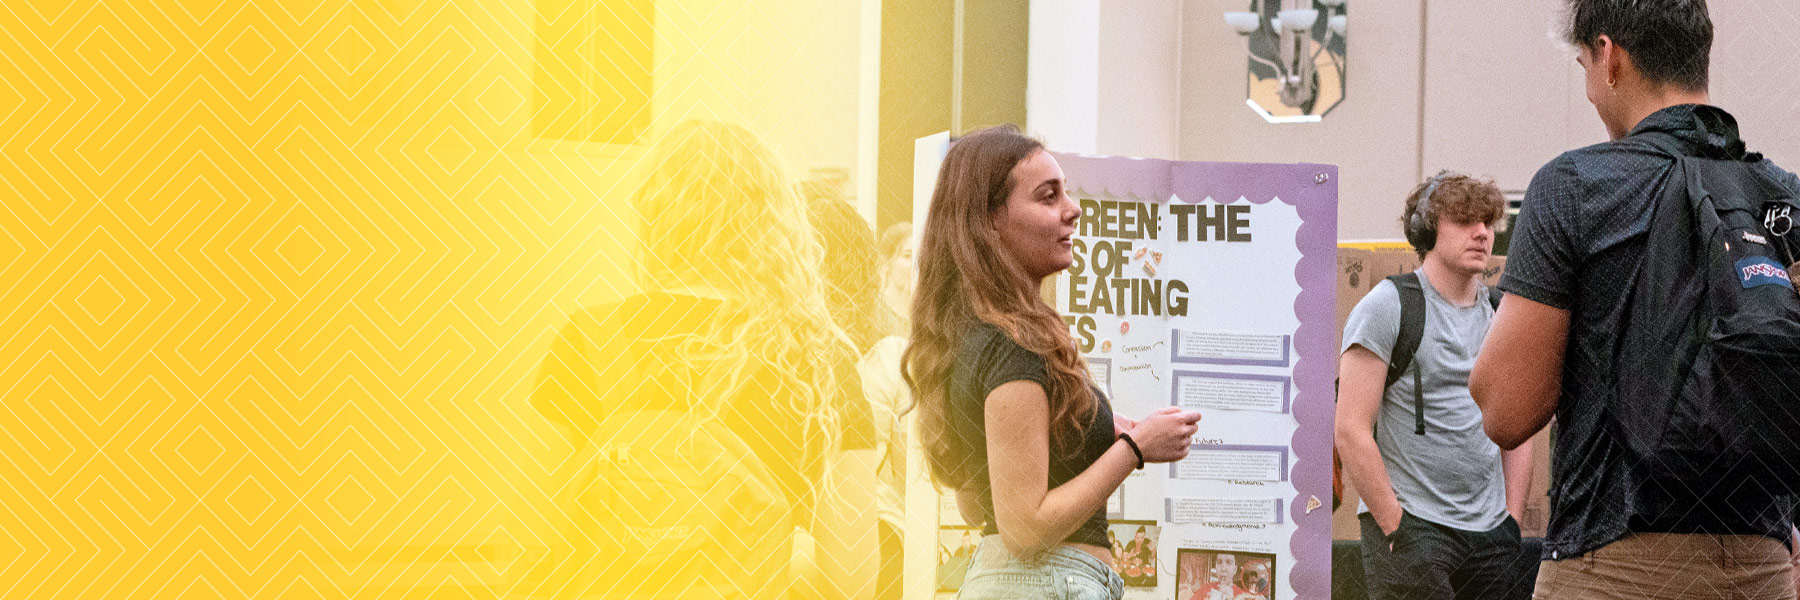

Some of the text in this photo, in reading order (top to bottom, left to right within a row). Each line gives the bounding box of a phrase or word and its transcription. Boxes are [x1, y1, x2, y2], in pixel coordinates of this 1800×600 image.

[1075, 198, 1252, 242] REEN: THE
[1091, 240, 1132, 278] OF
[1069, 274, 1189, 317] EATING
